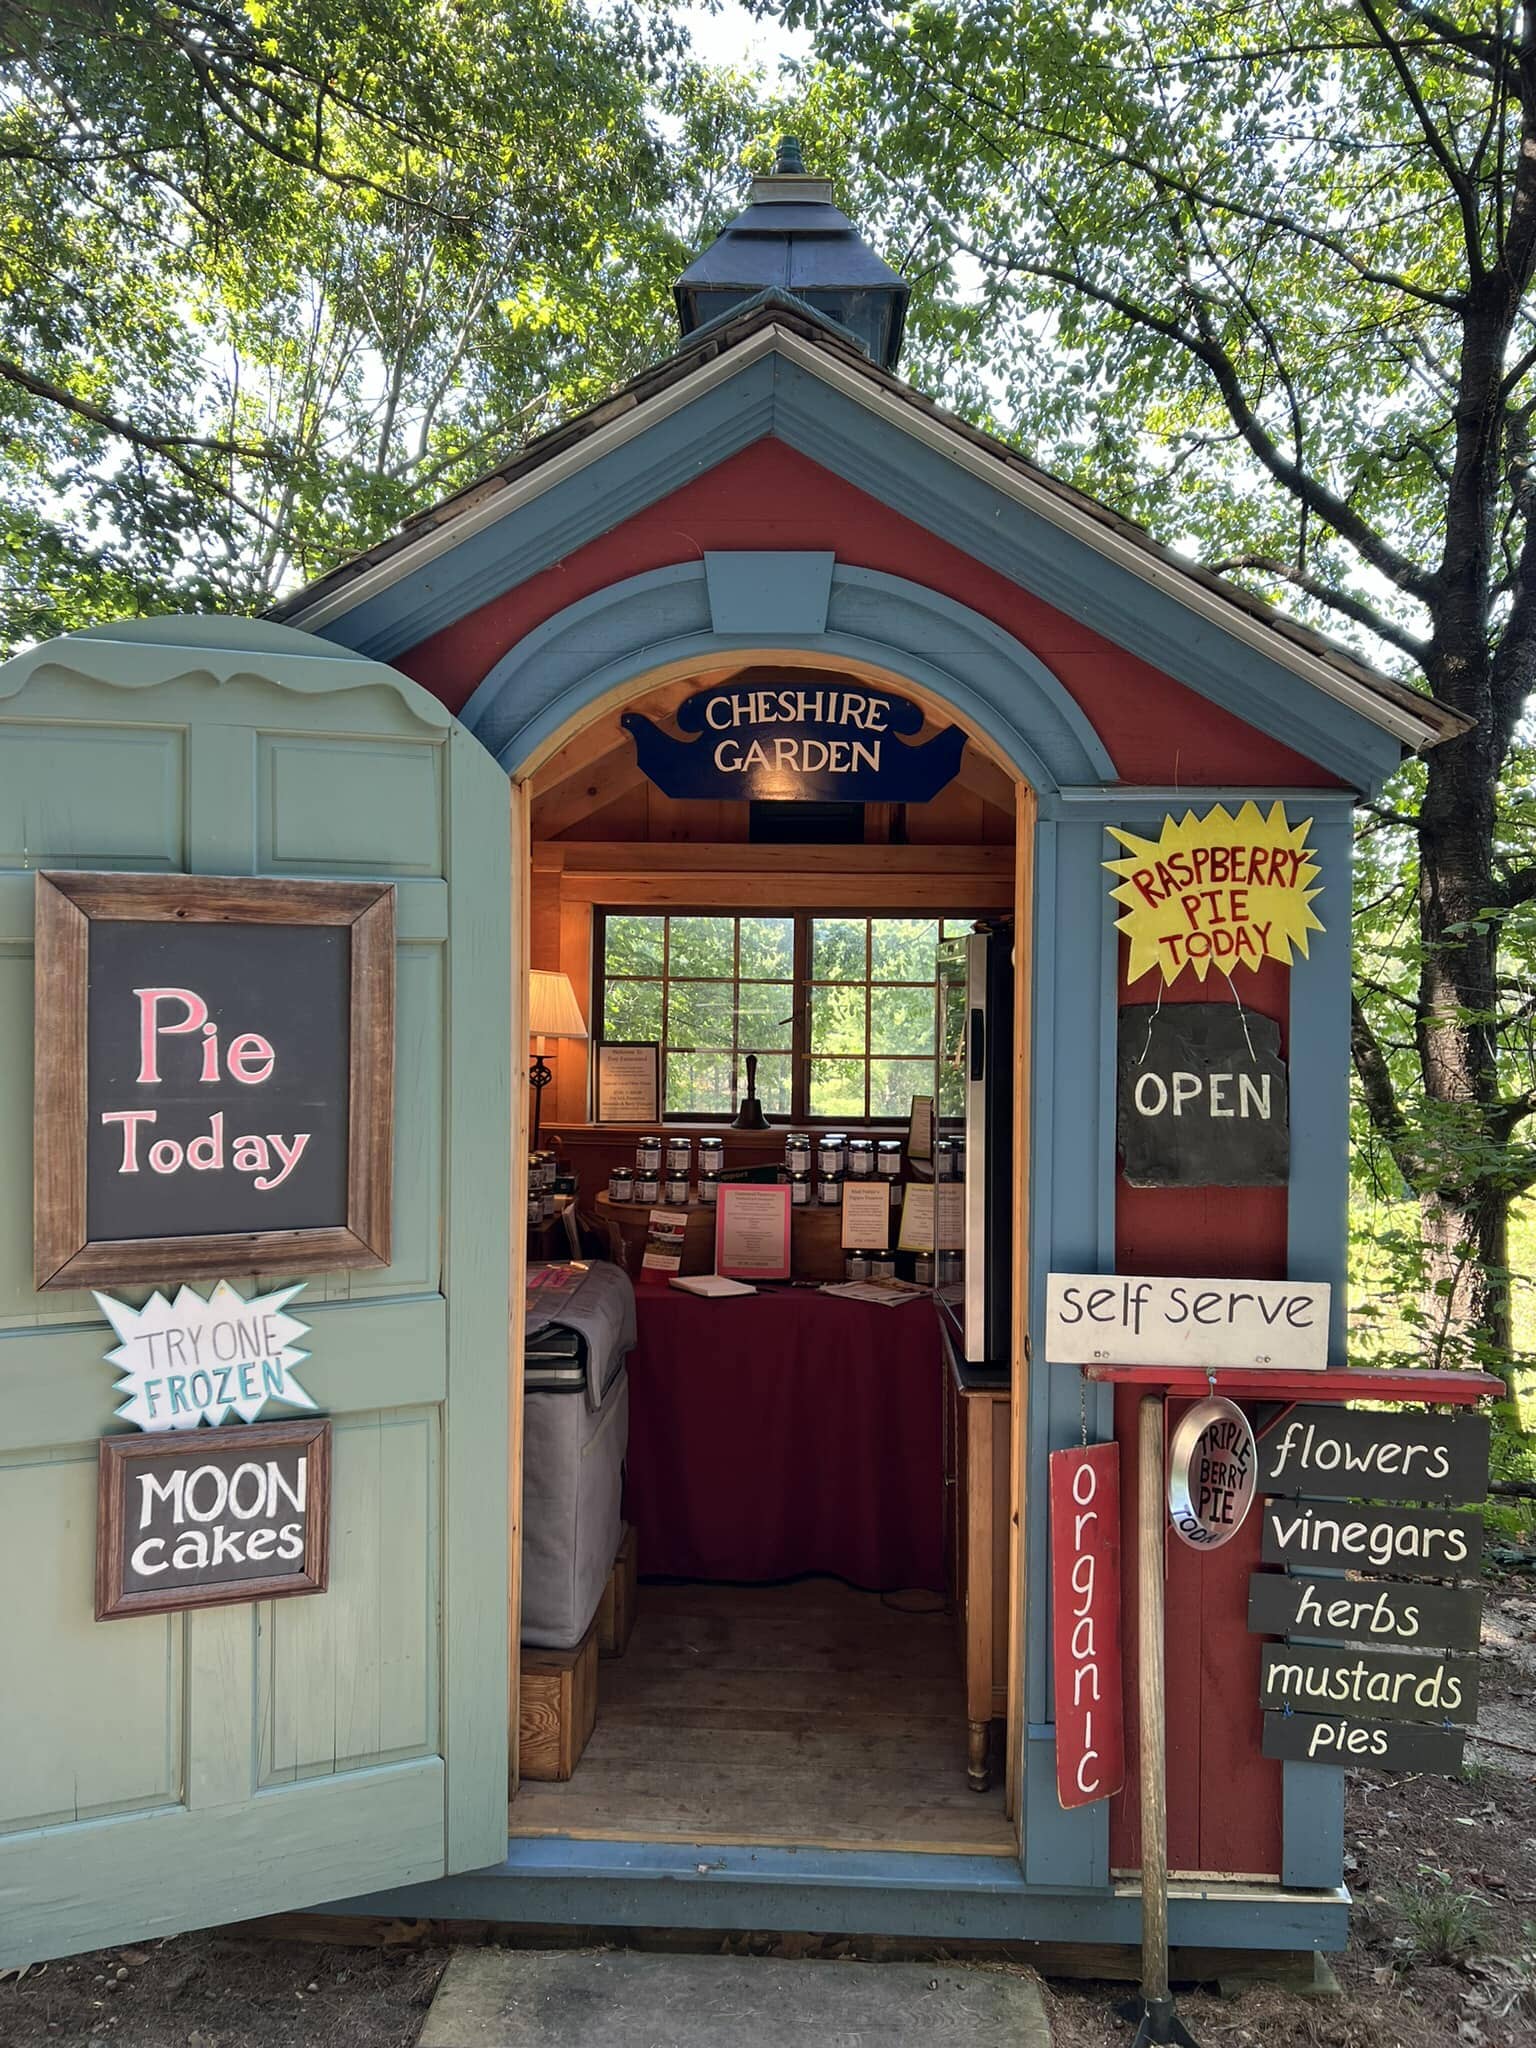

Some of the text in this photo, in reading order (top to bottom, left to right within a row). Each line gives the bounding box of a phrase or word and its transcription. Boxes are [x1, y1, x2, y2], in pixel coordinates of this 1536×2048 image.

[705, 690, 890, 732] CHESHIRE
[714, 737, 881, 773] GARDEN
[1131, 846, 1309, 909] RASPBERRY
[1181, 890, 1249, 929] PIE
[1158, 922, 1273, 966] TODAY
[133, 987, 275, 1085] Pie
[1134, 1072, 1272, 1120] OPEN
[102, 1110, 311, 1191] Today
[1059, 1282, 1315, 1335] self serve
[134, 1314, 283, 1369] TRY ONE
[144, 1357, 285, 1418] FROZEN
[1197, 1422, 1252, 1467] TRIPLE
[1269, 1422, 1451, 1479] flowers
[136, 1456, 307, 1530] MOON
[1200, 1458, 1248, 1490] BERRY
[1198, 1486, 1235, 1524] PIE
[131, 1522, 305, 1576] cakes
[1271, 1509, 1468, 1565] vinegars
[1295, 1584, 1420, 1637] herbs
[1267, 1660, 1463, 1710] mustards
[1308, 1720, 1389, 1758] pies
